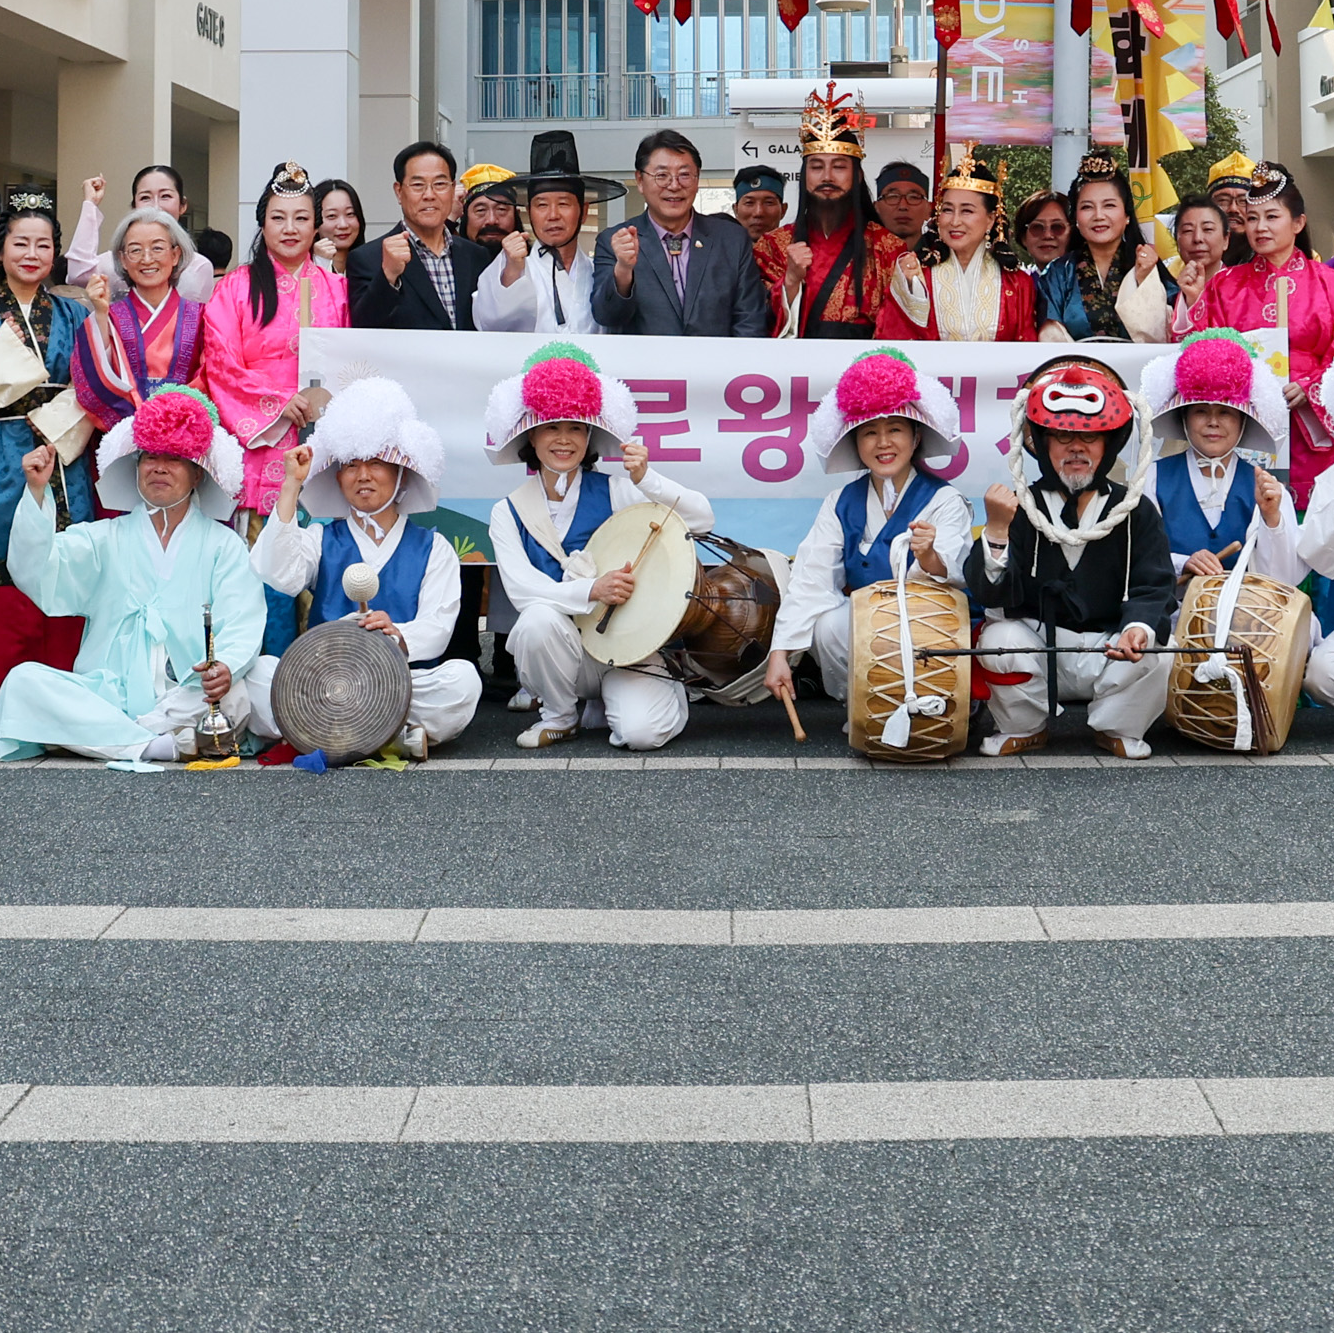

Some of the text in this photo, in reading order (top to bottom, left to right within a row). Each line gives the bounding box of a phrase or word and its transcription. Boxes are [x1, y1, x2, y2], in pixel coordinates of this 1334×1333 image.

[196, 2, 225, 48] GATE 8
[768, 144, 802, 154] GALA
[487, 374, 821, 483] 로왕
